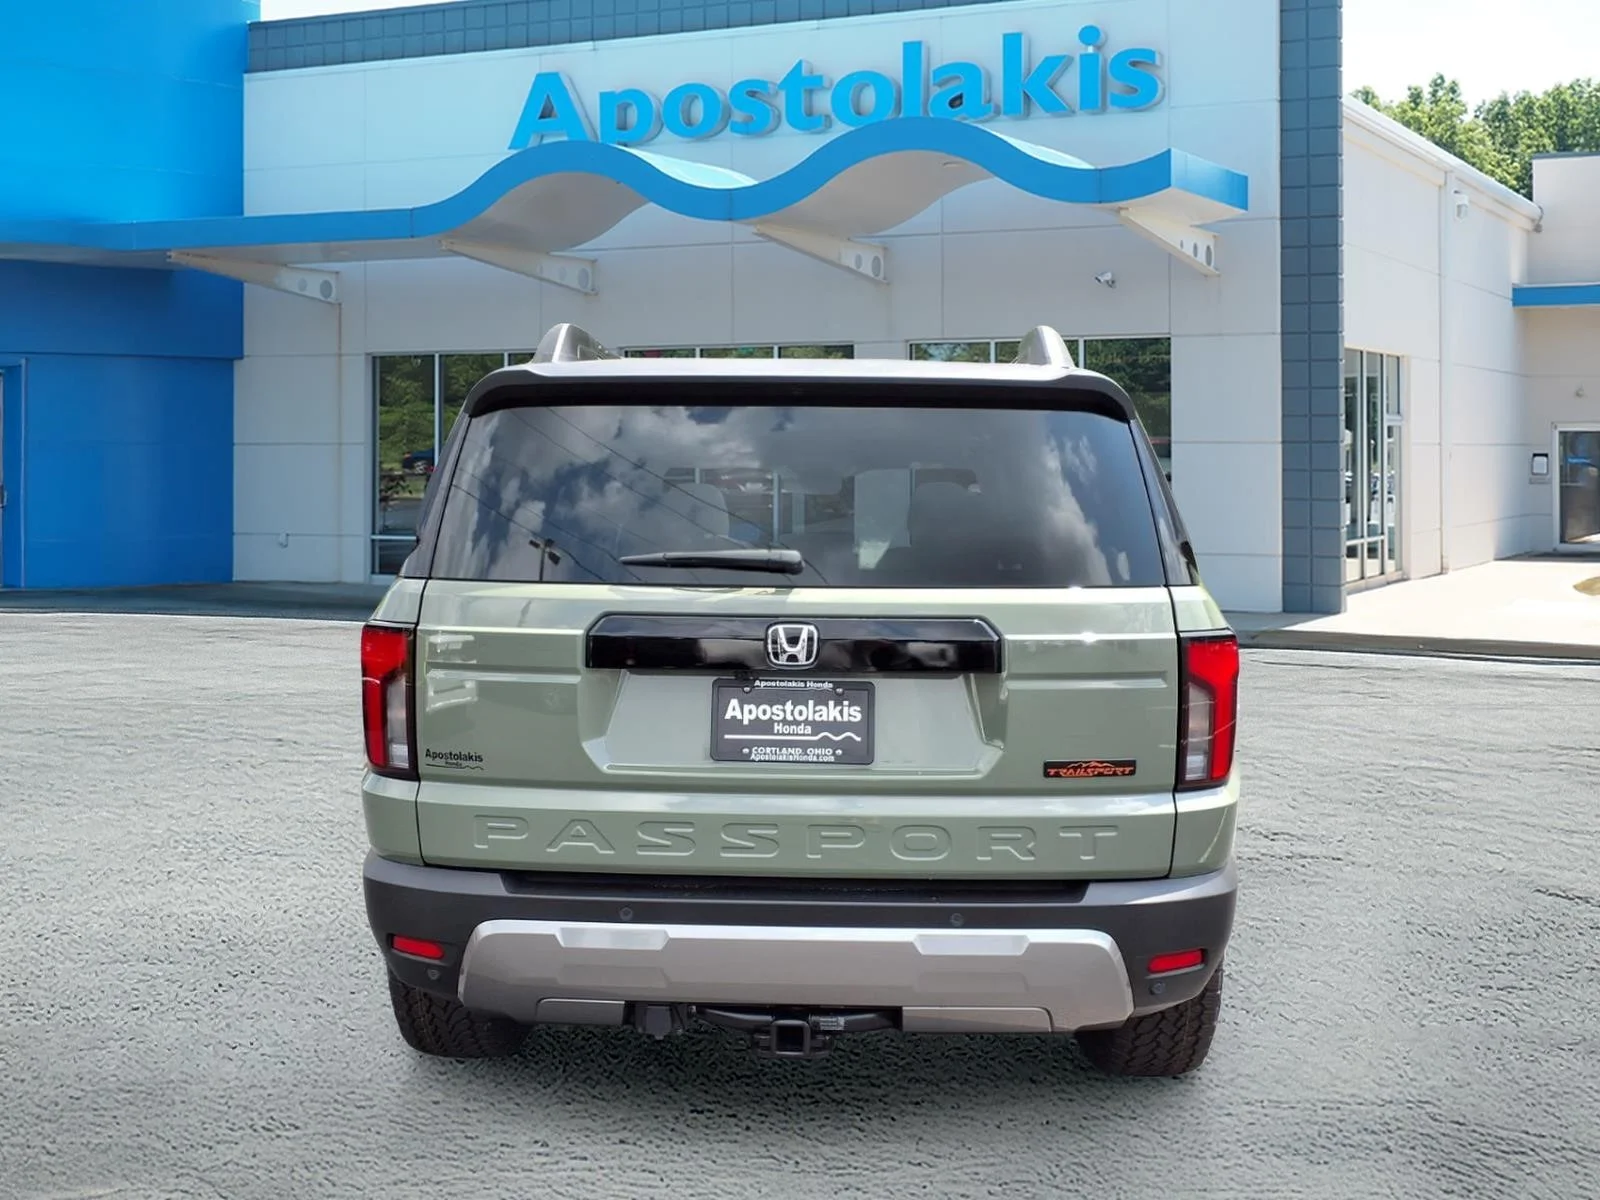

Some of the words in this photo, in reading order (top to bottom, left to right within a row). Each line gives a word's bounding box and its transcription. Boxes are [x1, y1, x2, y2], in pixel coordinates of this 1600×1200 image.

[508, 25, 1164, 151] Apostolakis
[754, 680, 805, 688] Apostolakis
[724, 698, 862, 725] Apostolakis
[774, 722, 812, 734] Honda
[425, 748, 484, 762] Apostolakis
[806, 747, 834, 755] OHIO
[473, 813, 1119, 862] PASSPORT
